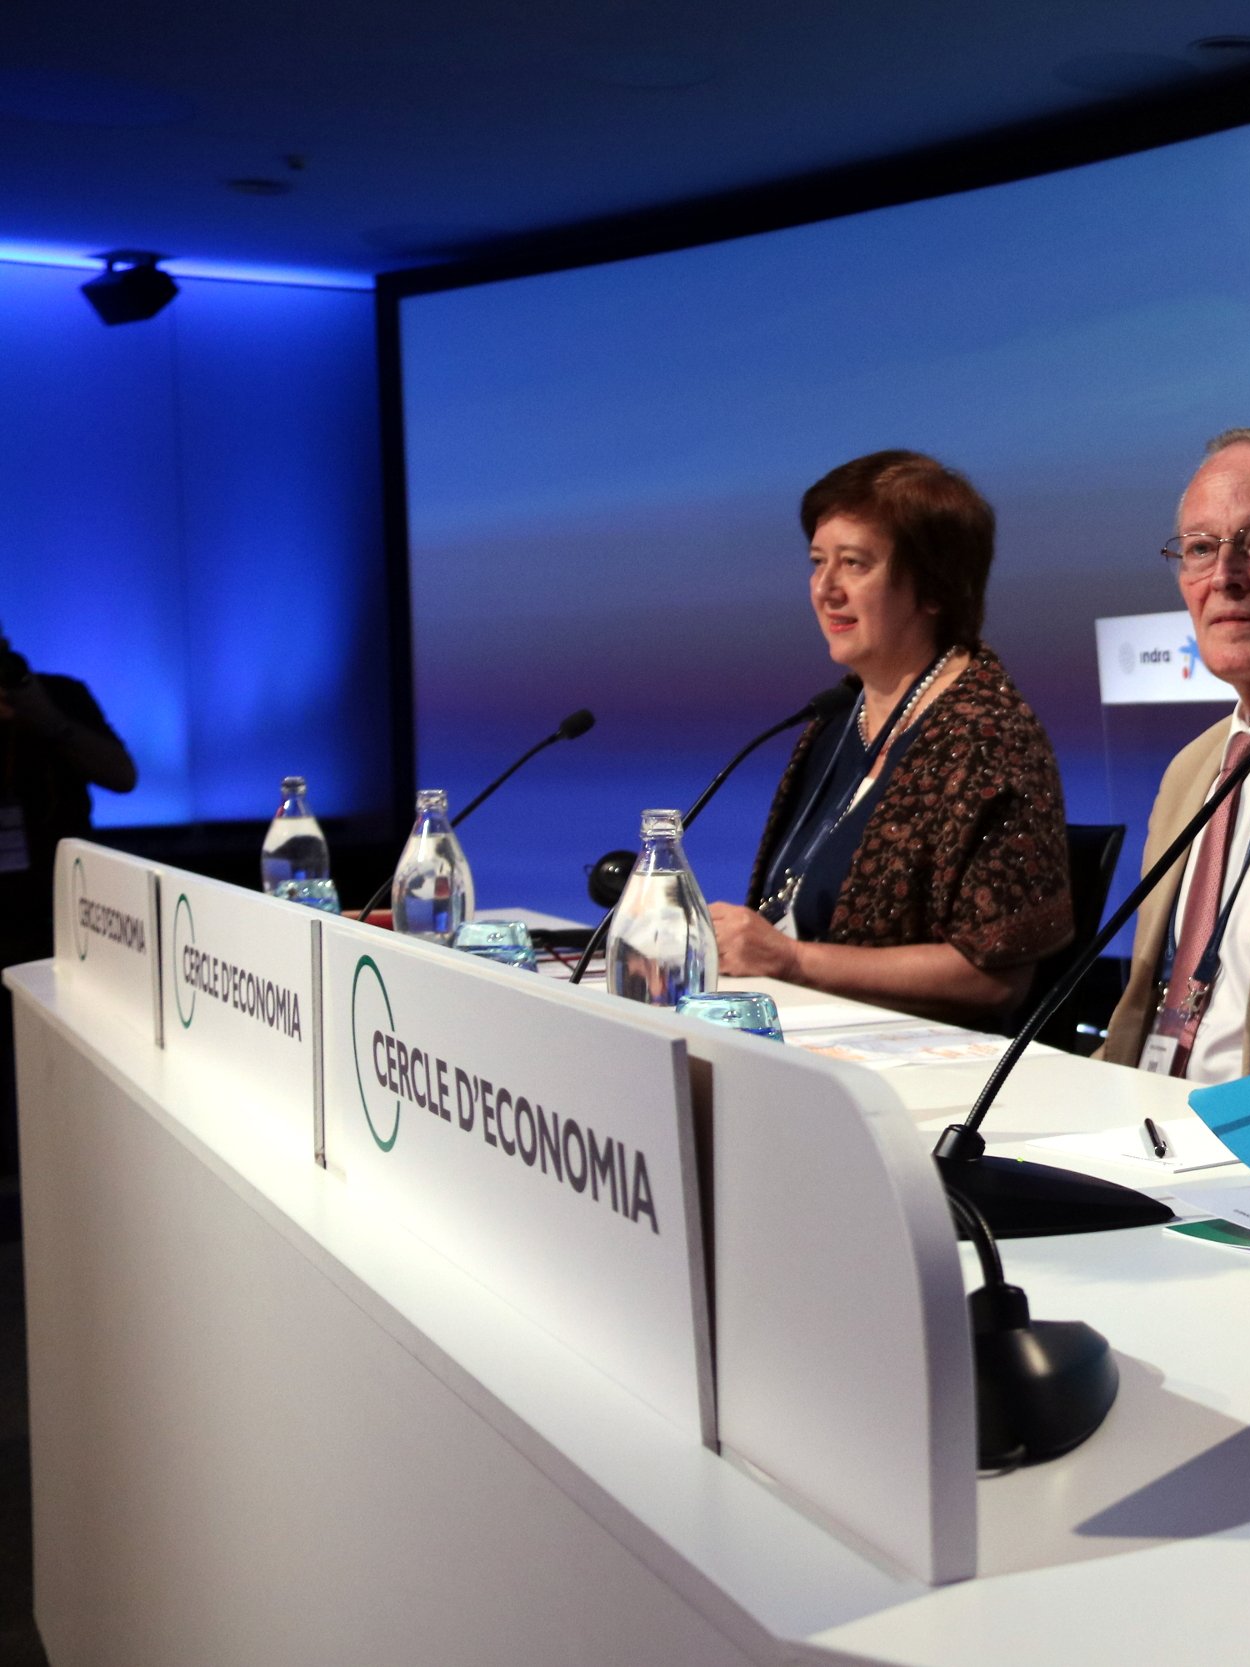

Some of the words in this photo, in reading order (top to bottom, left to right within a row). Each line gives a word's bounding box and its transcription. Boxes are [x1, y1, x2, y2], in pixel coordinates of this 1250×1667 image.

[1139, 648, 1170, 663] indra
[183, 944, 219, 999] CERCLE
[221, 961, 302, 1042] D'ECONOMIA
[373, 1030, 452, 1123] CERCLE
[454, 1066, 660, 1235] D'ECONOMIA
